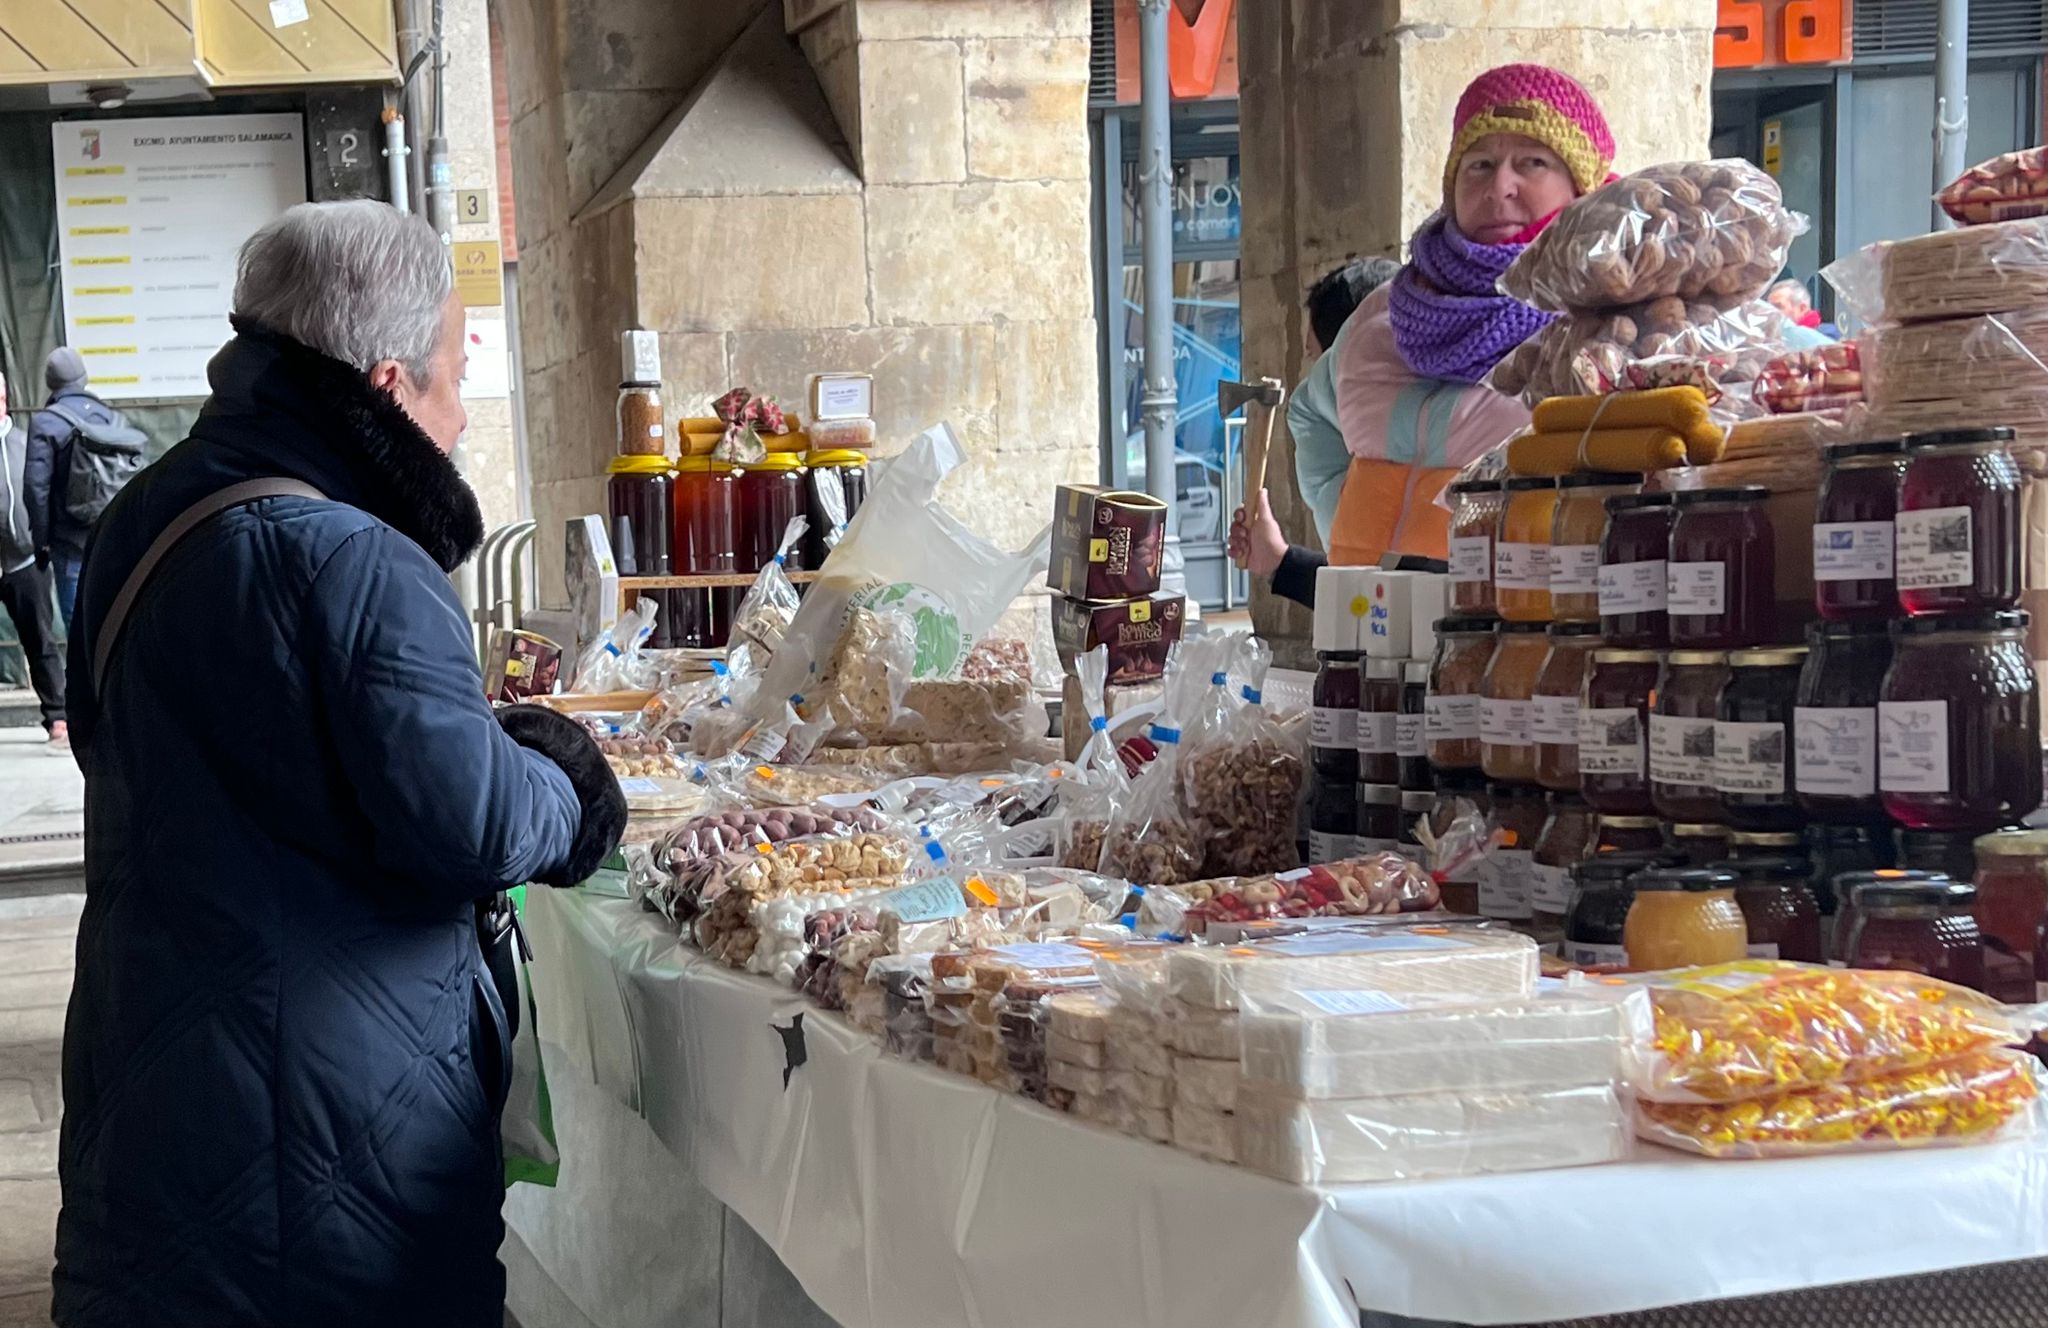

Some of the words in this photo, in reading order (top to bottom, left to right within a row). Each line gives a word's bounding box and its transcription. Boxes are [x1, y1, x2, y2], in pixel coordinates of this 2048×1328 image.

[169, 134, 236, 145] AYUNTAMIENTO
[237, 132, 293, 143] SALAMANCA
[340, 133, 358, 163] 2
[467, 195, 478, 216] 3
[840, 577, 882, 628] ATERIAL
